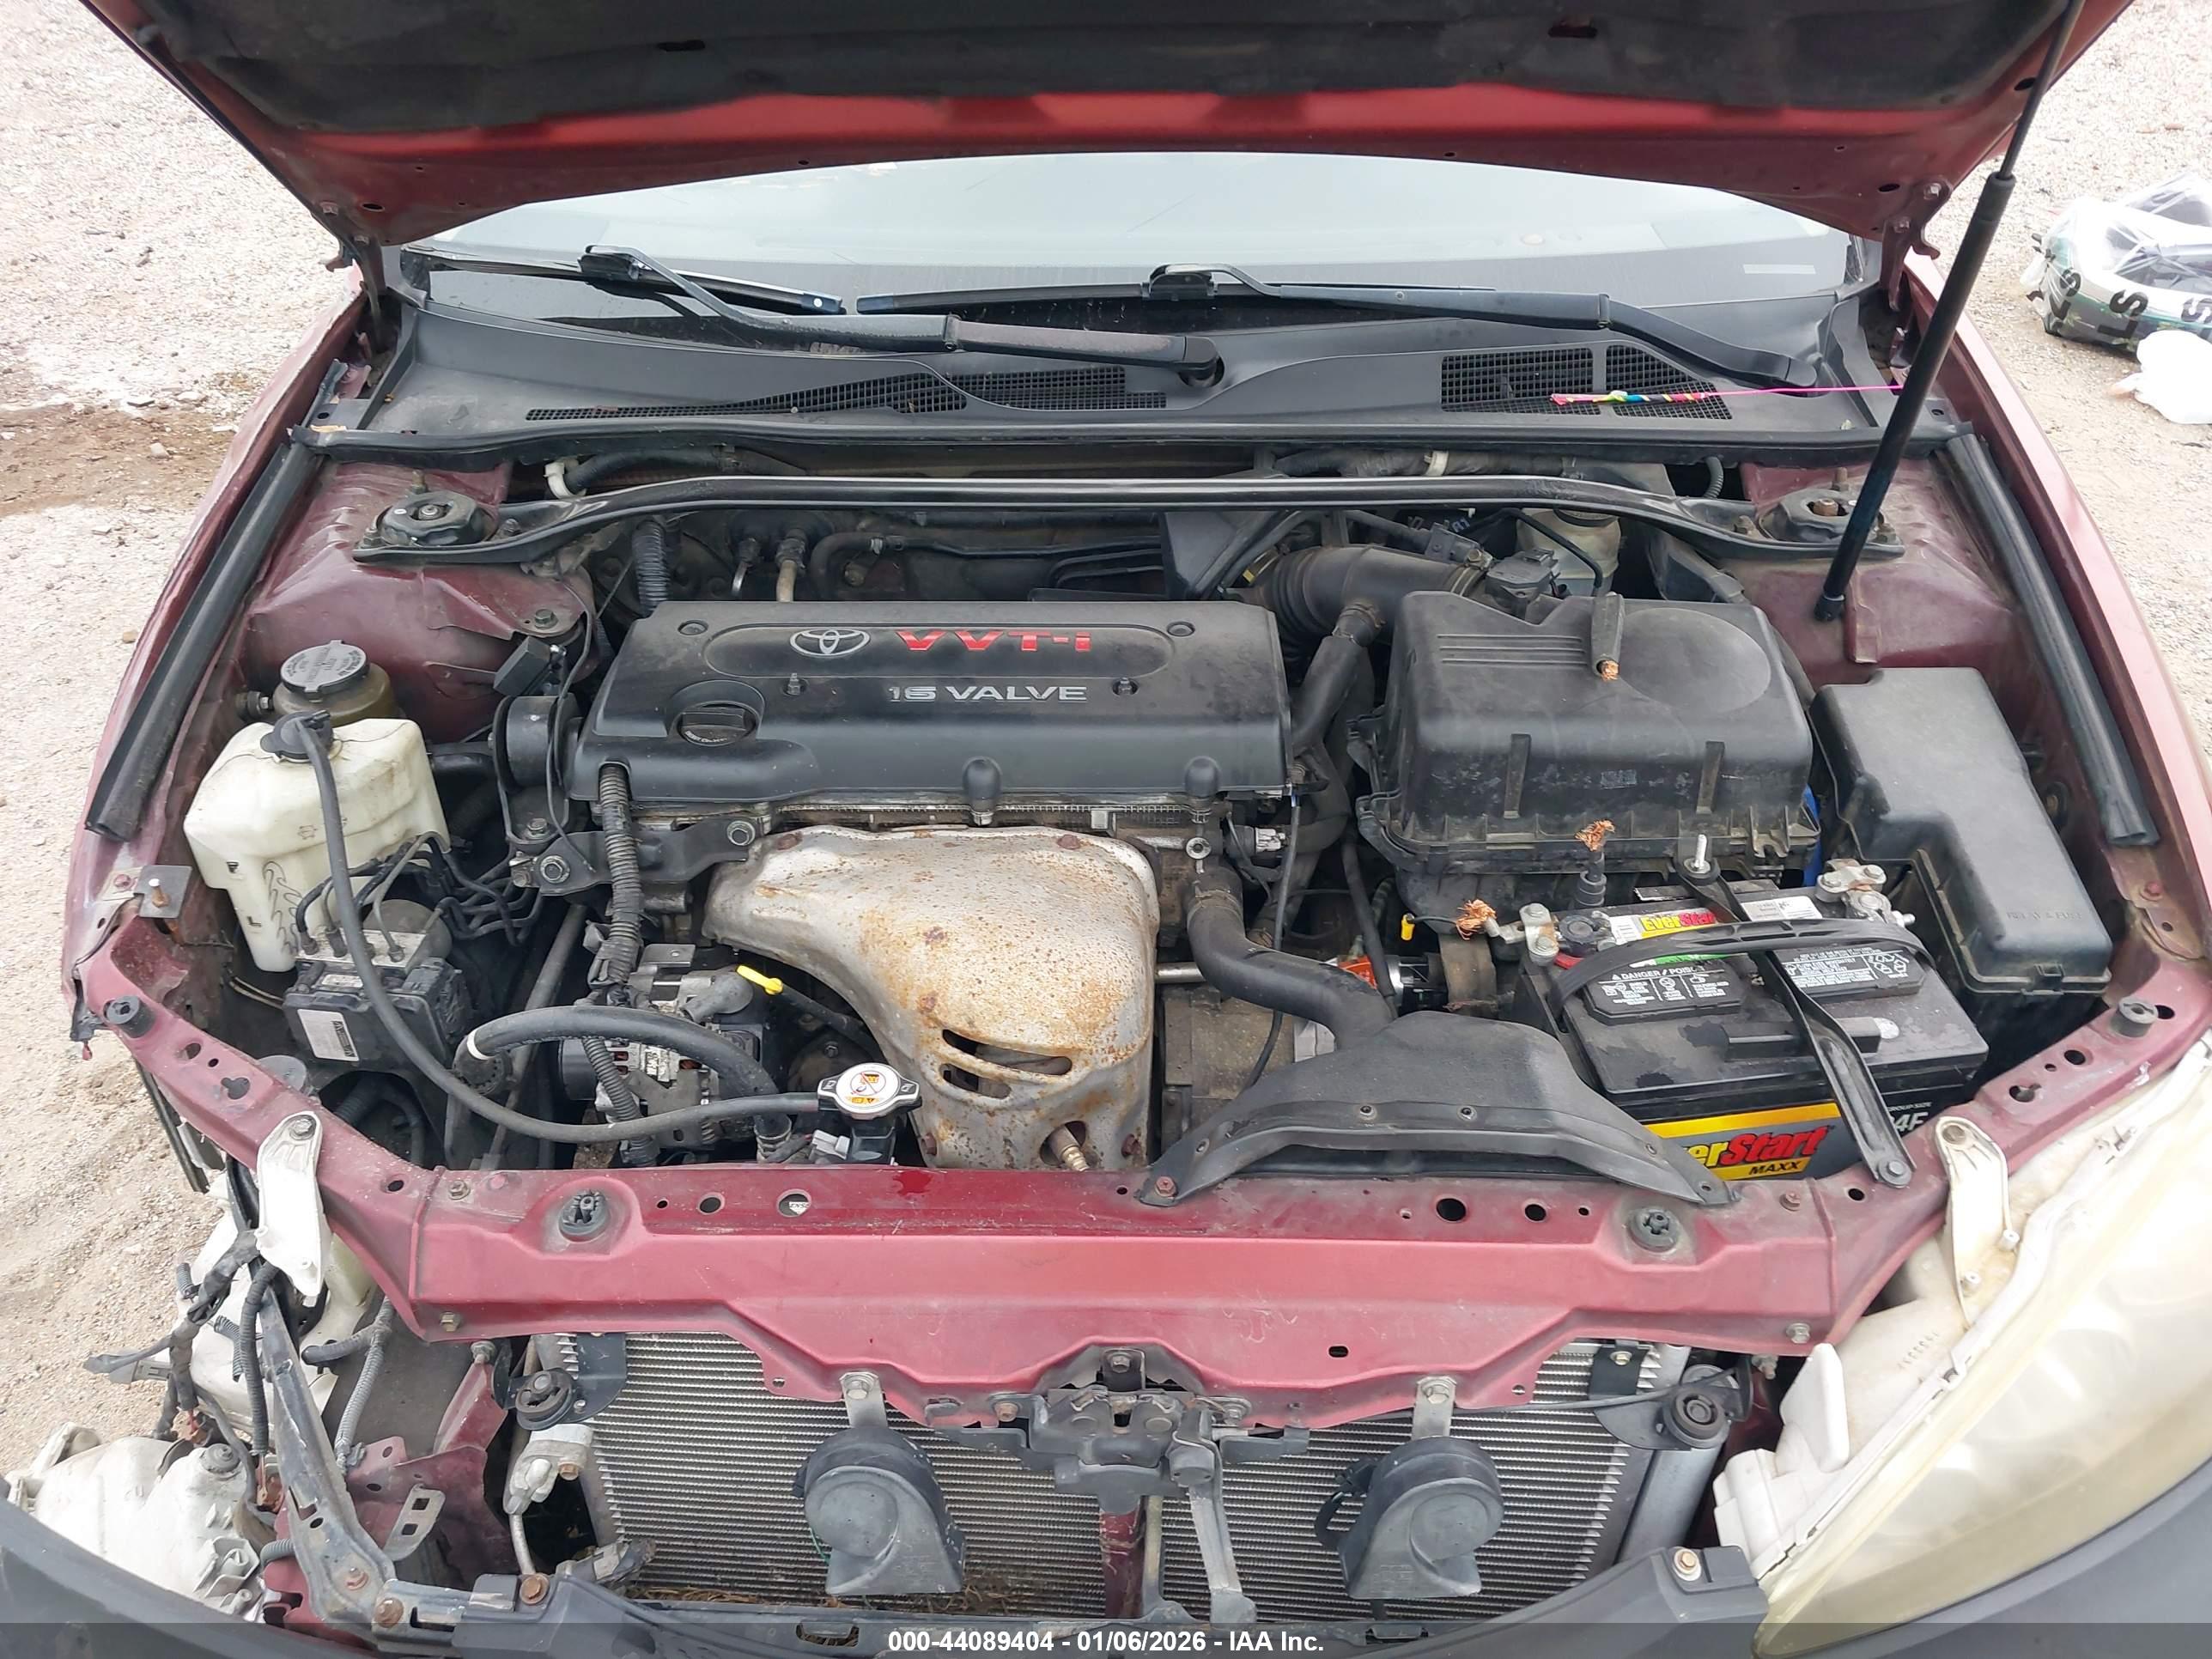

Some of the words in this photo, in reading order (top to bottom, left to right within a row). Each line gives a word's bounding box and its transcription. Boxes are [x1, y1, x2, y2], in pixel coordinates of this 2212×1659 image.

[888, 686, 938, 702] 16
[945, 686, 1088, 702] VALVE
[1640, 912, 1716, 931] EverStar
[1620, 969, 1661, 980] DANGER
[1893, 1112, 1929, 1132] 4F
[1748, 1161, 1802, 1176] MAXX
